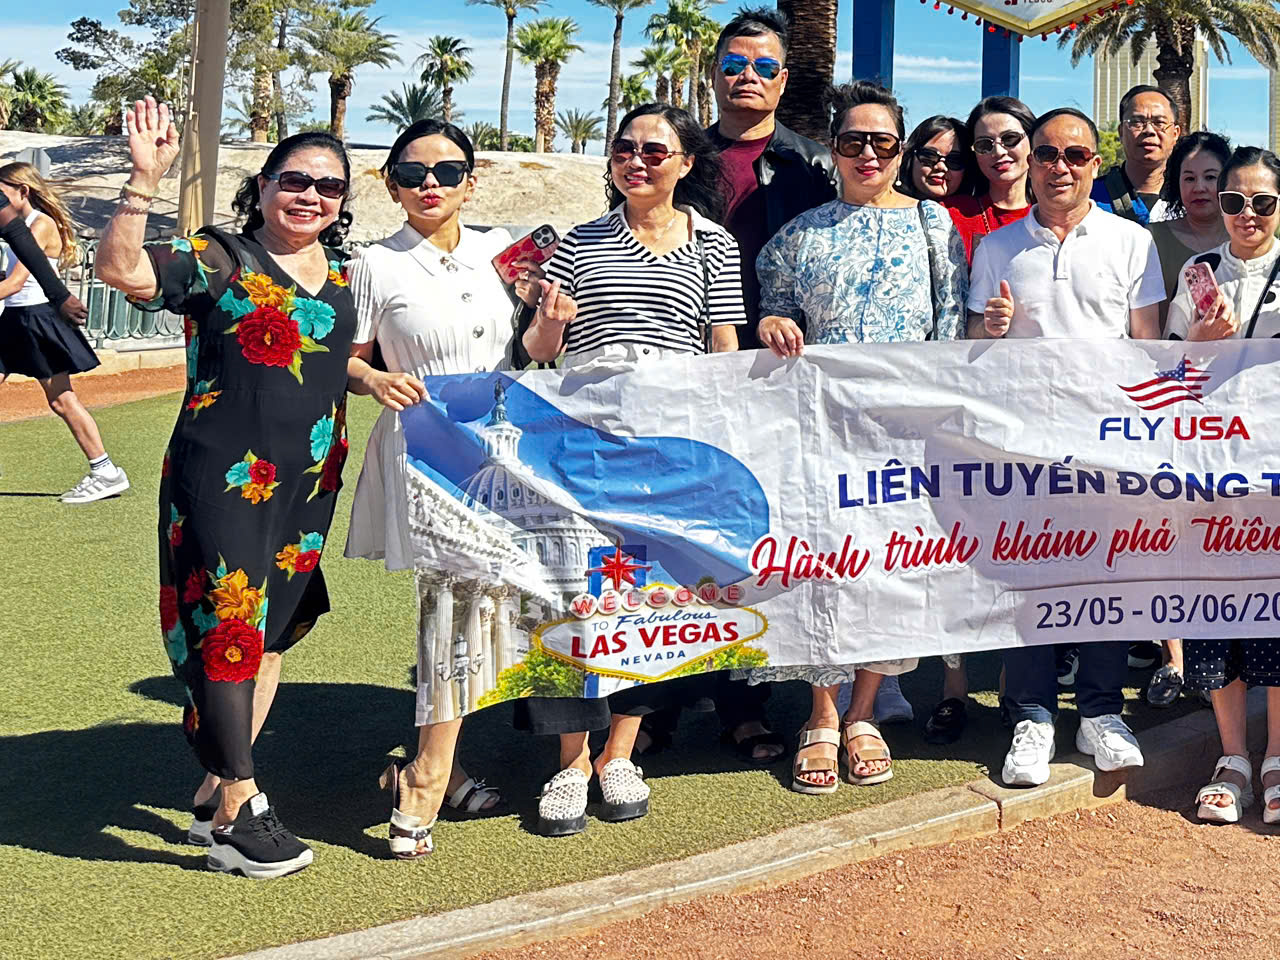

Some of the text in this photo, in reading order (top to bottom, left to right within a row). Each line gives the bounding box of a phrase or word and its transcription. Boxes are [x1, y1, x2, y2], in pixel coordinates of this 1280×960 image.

[1100, 415, 1251, 441] FLY USA
[838, 458, 941, 508] LIÊN
[953, 455, 1106, 497] TUYẾN
[1116, 462, 1249, 502] ĐÔNG
[752, 534, 871, 587] Hành
[884, 521, 979, 571] trình
[993, 517, 1098, 563] khám
[1106, 517, 1176, 568] phá
[574, 585, 740, 615] WELCOME
[1036, 596, 1125, 629] 23/05
[592, 610, 717, 632] TO Fabulous
[571, 621, 739, 659] LAS VEGAS
[620, 650, 686, 666] NEVADA
